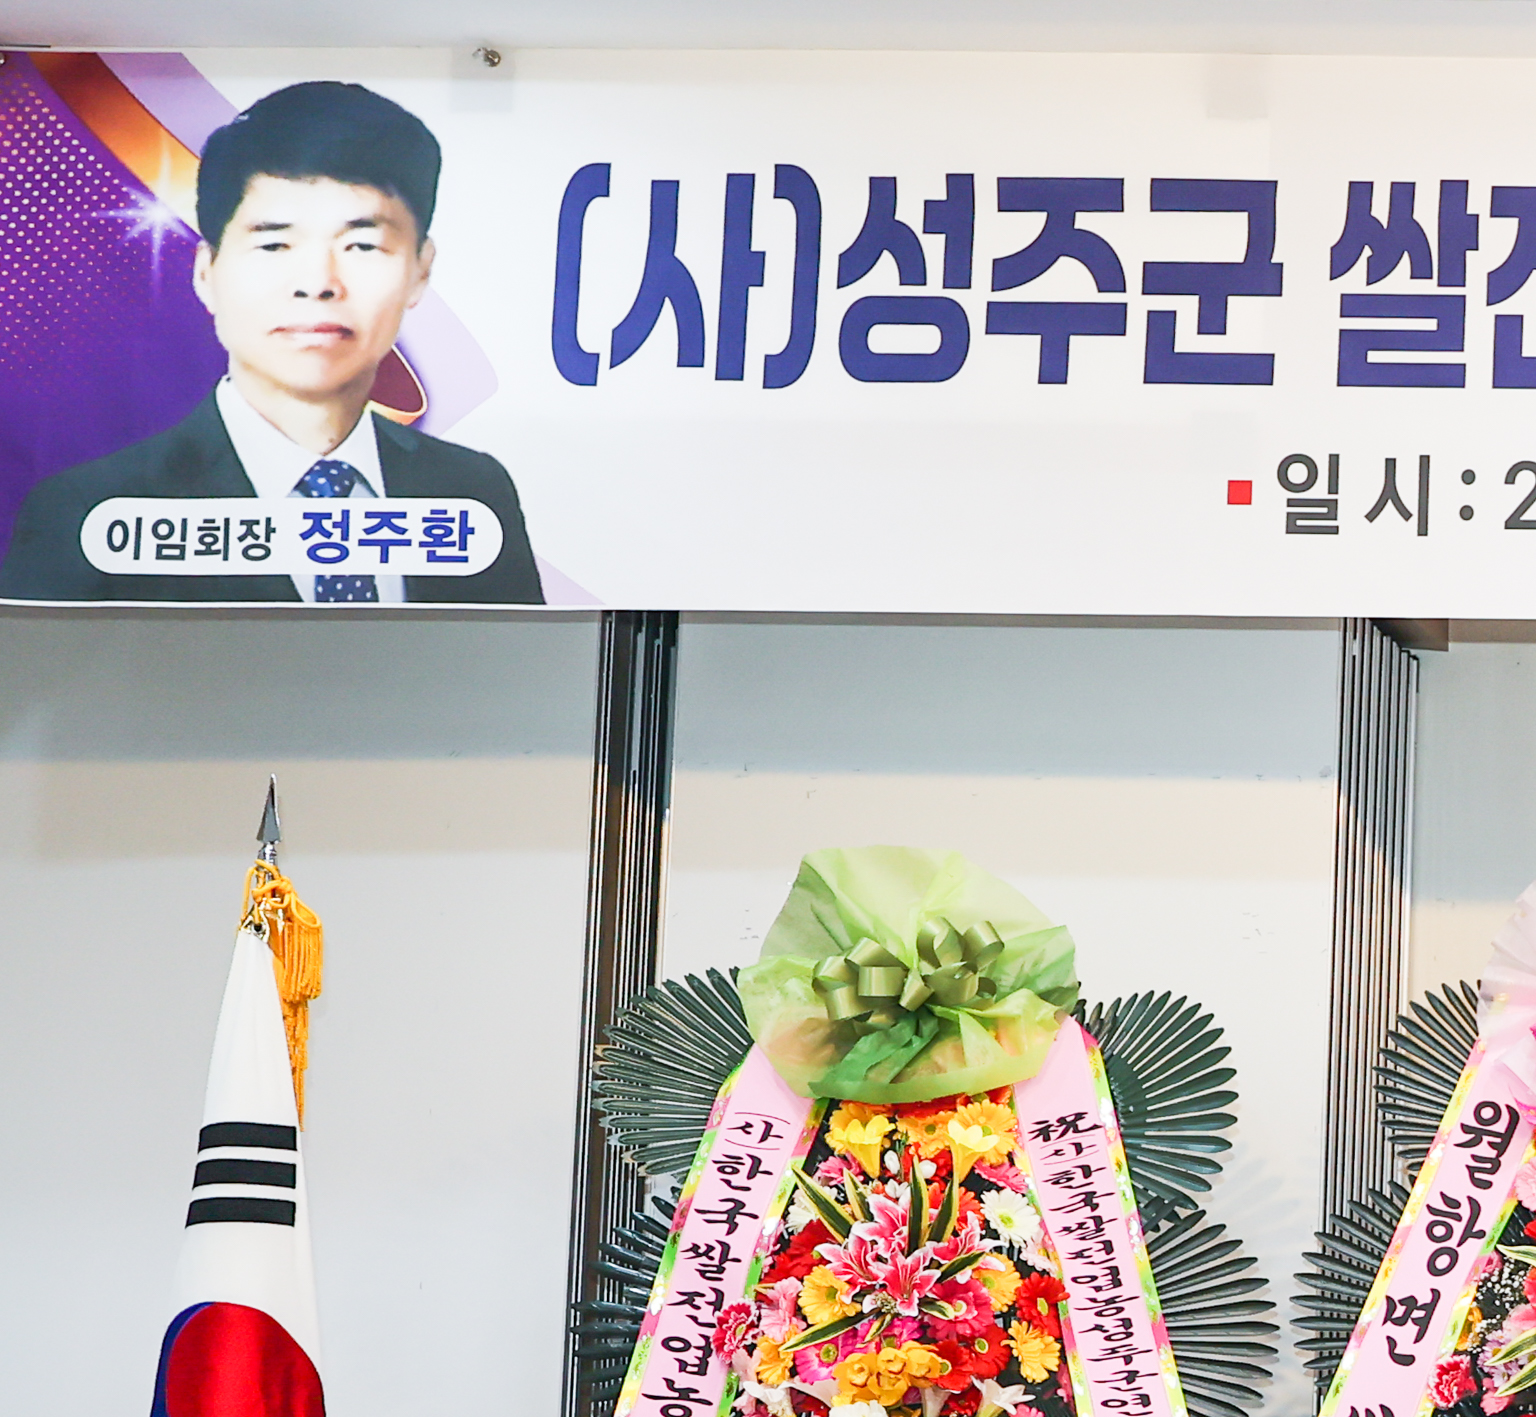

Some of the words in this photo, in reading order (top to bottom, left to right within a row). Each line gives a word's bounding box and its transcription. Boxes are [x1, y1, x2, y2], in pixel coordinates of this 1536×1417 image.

[551, 162, 1284, 390] (사)성주군
[105, 515, 277, 564] 이임회장
[296, 506, 476, 566] 정주환
[1381, 1098, 1521, 1368] 월항면
